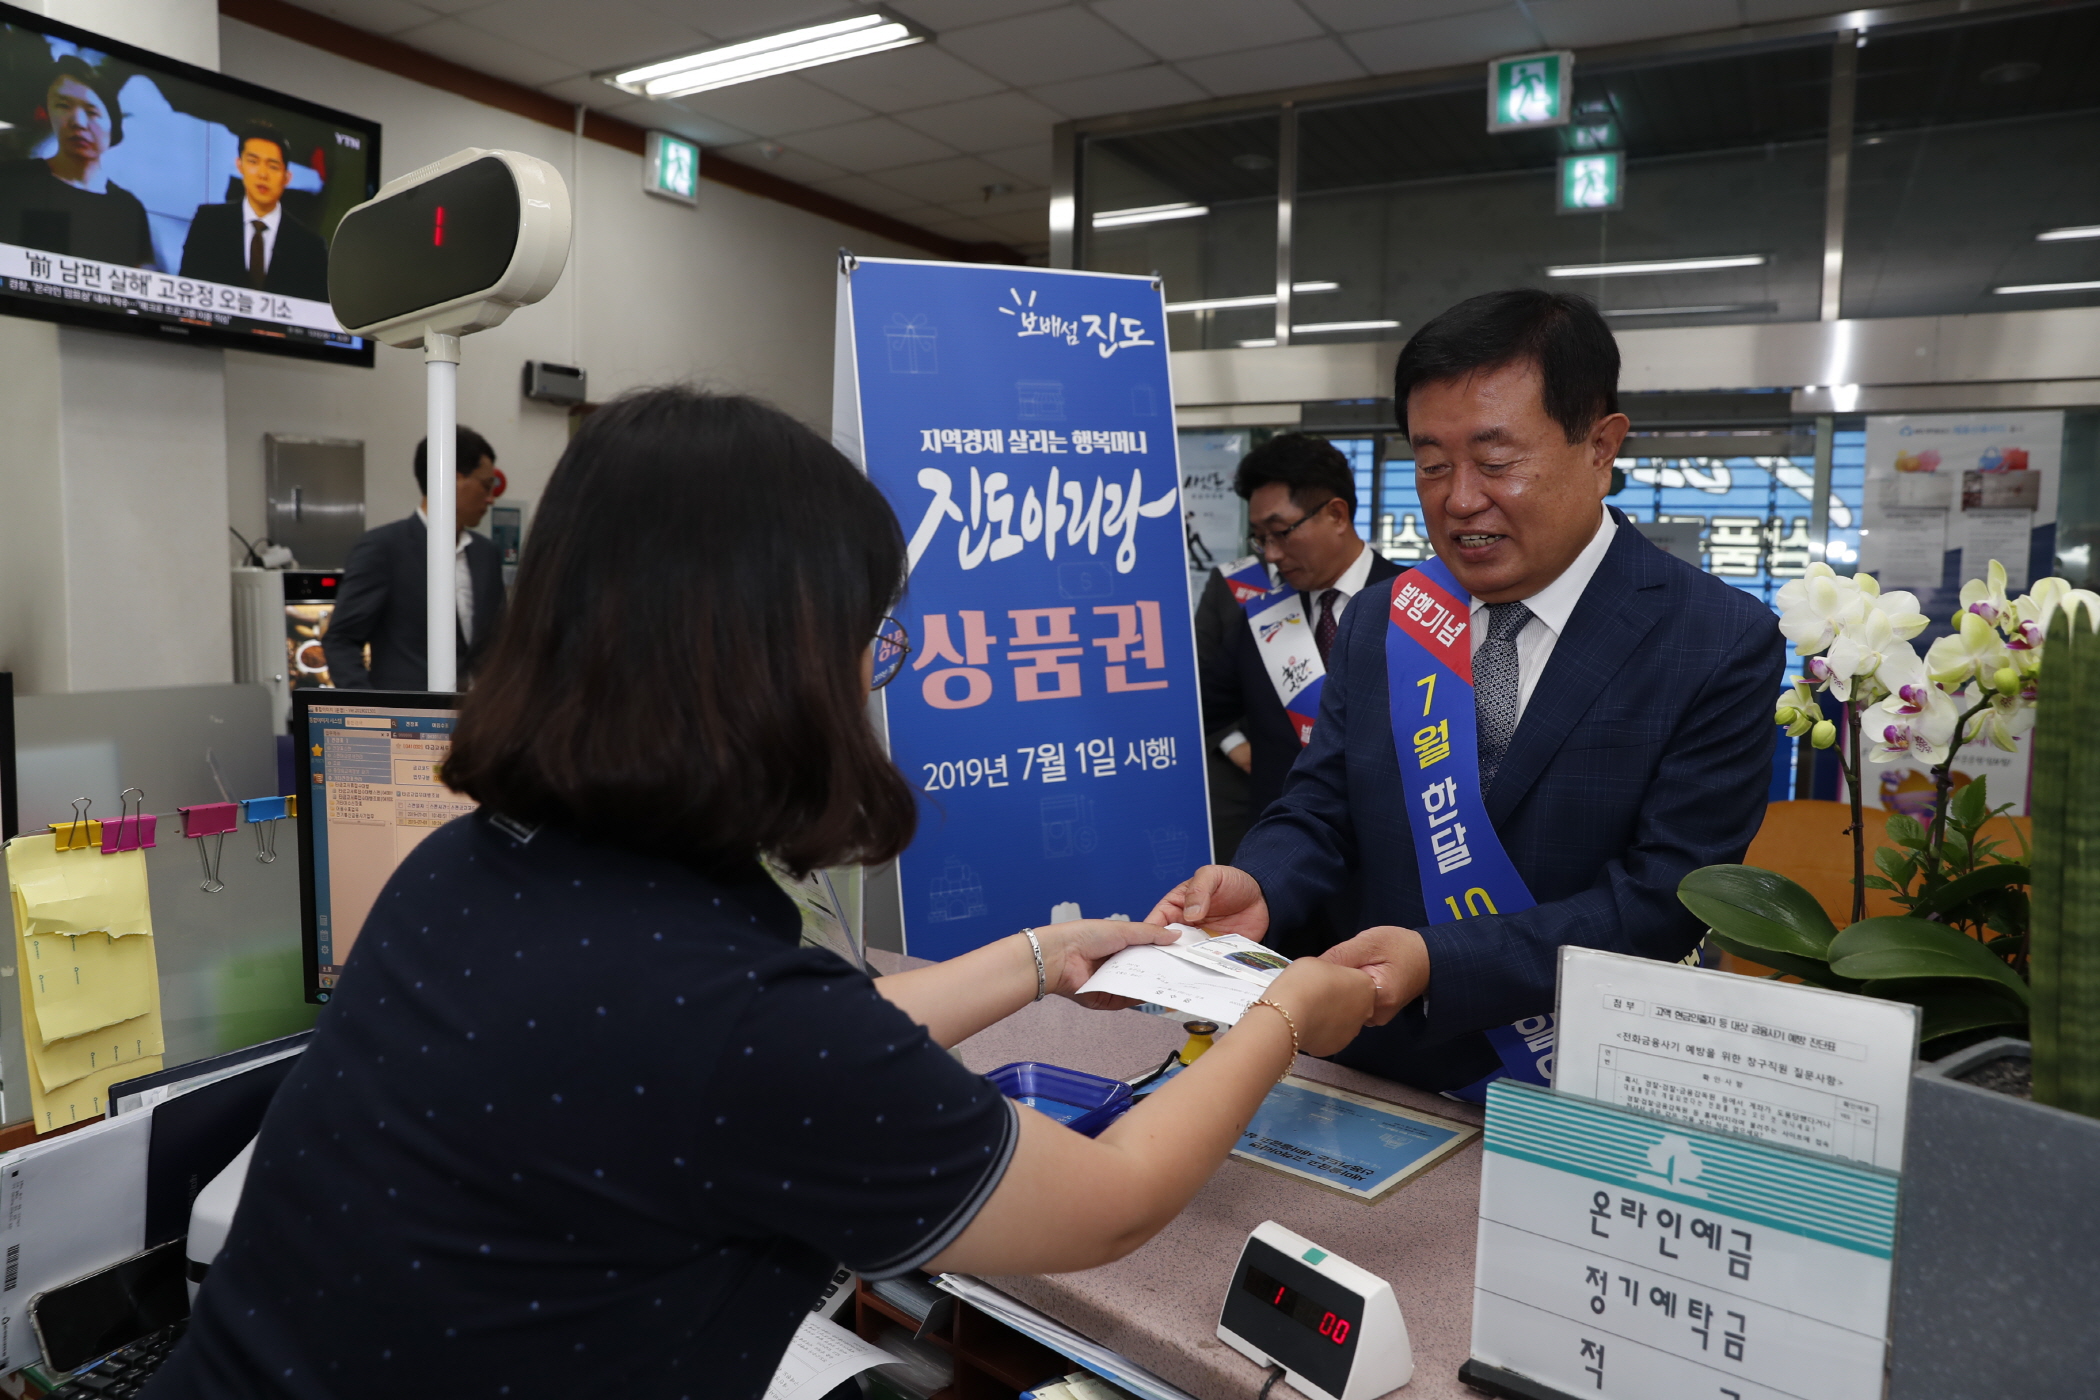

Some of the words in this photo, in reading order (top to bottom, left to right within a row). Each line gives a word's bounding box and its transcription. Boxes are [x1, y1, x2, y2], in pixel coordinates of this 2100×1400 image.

[335, 132, 360, 150] YTN
[433, 206, 445, 246] 1
[60, 260, 101, 288] 남편
[158, 278, 213, 308] 고유정
[219, 290, 253, 314] 오늘
[260, 297, 293, 319] 기소
[1017, 311, 1080, 346] 보배섬
[1081, 312, 1155, 359] 진도
[920, 428, 1004, 454] 지역경제
[1007, 429, 1068, 454] 살리는
[1071, 430, 1148, 454] 행복머니
[906, 466, 1177, 578] 진도아리랑
[1392, 581, 1468, 648] 발행기념
[912, 600, 1169, 710] 상품권
[922, 753, 1010, 792] 2019년
[1017, 742, 1068, 784] 7월
[1074, 737, 1117, 778] 1일
[1124, 736, 1178, 771] 시행!
[1421, 776, 1472, 875] 한달
[1655, 1006, 1672, 1018] 고액
[1674, 1010, 1716, 1025] 현금인출자
[1719, 1018, 1728, 1029] 등
[1731, 1021, 1749, 1033] 대상
[1751, 1024, 1785, 1041] 금융사기
[1788, 1034, 1807, 1046] 예방
[1810, 1038, 1836, 1052] 진단표
[1685, 1044, 1716, 1059] 예방을
[1722, 1051, 1741, 1064] 위한
[1747, 1056, 1788, 1075] 창구직원
[1588, 1190, 1754, 1282] 온라인예금
[1273, 1286, 1286, 1305] 1
[1585, 1265, 1747, 1363] 정기예탁금
[1318, 1311, 1351, 1345] 00
